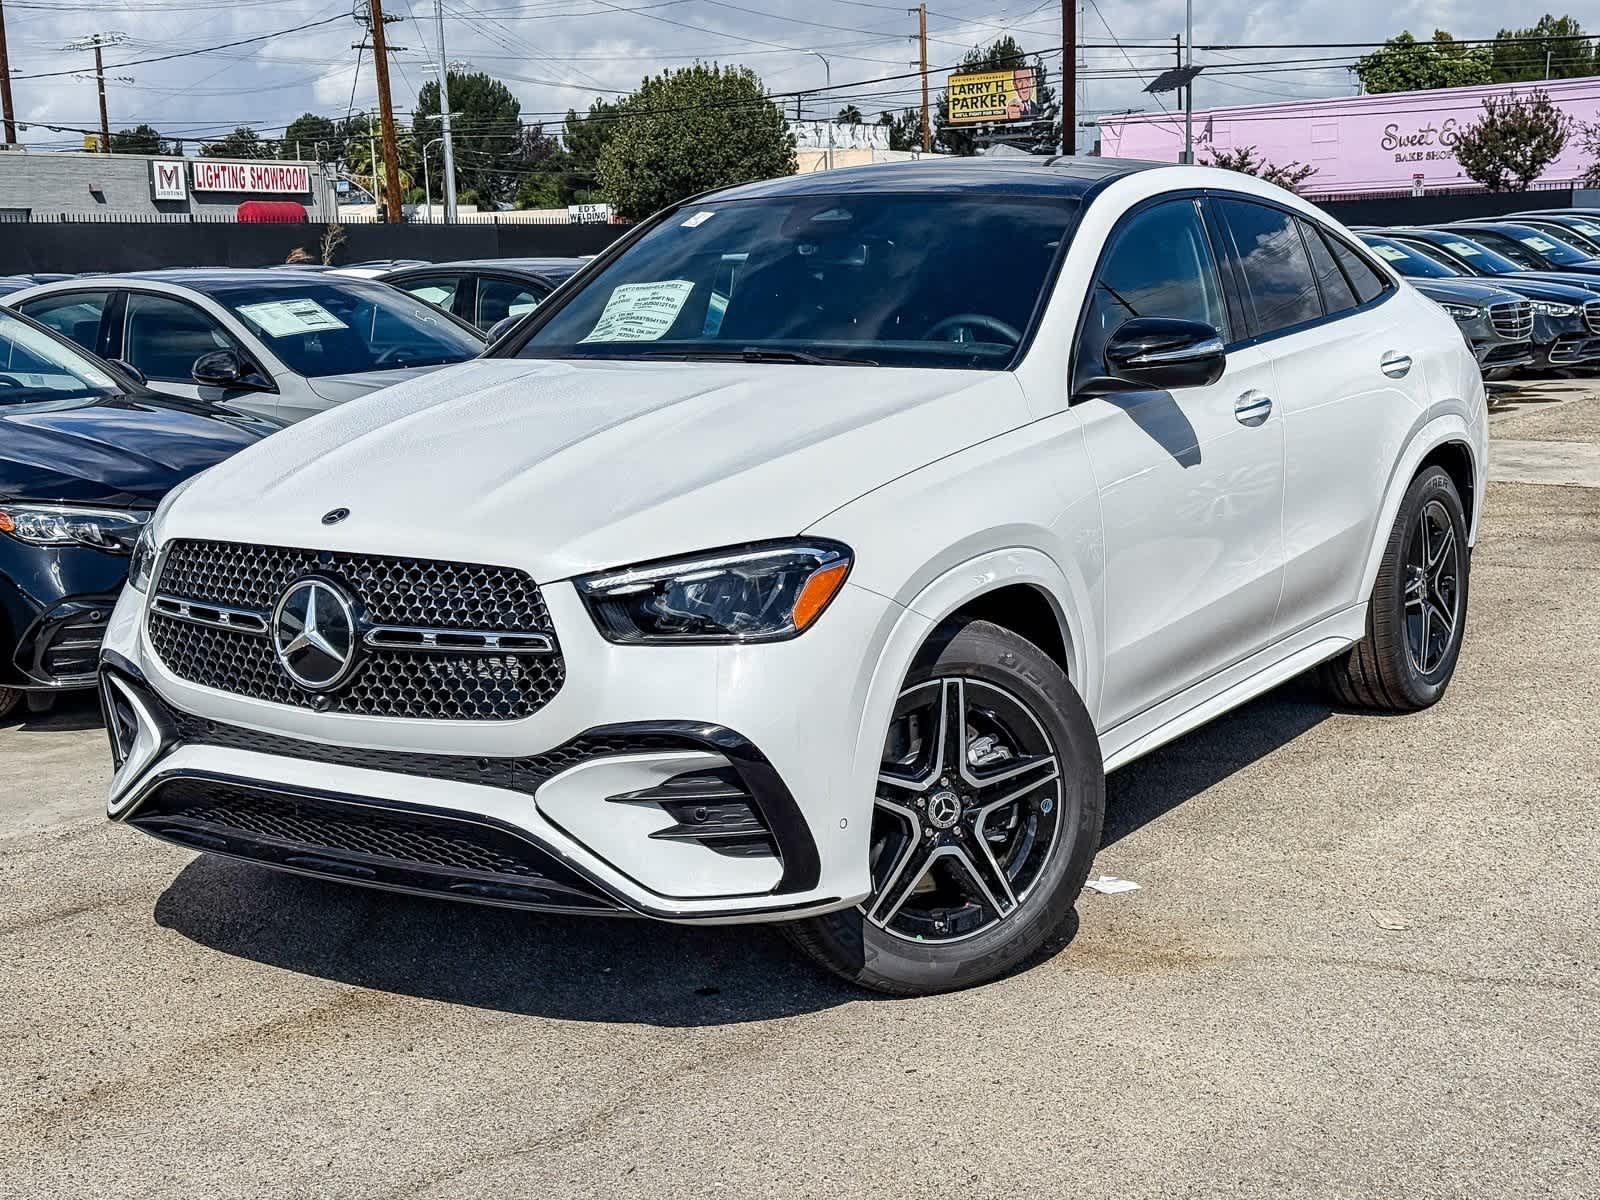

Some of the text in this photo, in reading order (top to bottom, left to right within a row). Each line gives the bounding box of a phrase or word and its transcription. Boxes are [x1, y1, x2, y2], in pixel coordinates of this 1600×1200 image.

[952, 82, 991, 96] LARRY
[952, 94, 1007, 110] PARKER
[1381, 122, 1438, 151] Sweet
[1395, 150, 1455, 163] BAKE SHOP
[195, 164, 308, 191] LIGHTING SHOWROOM
[570, 212, 606, 221] WELDING
